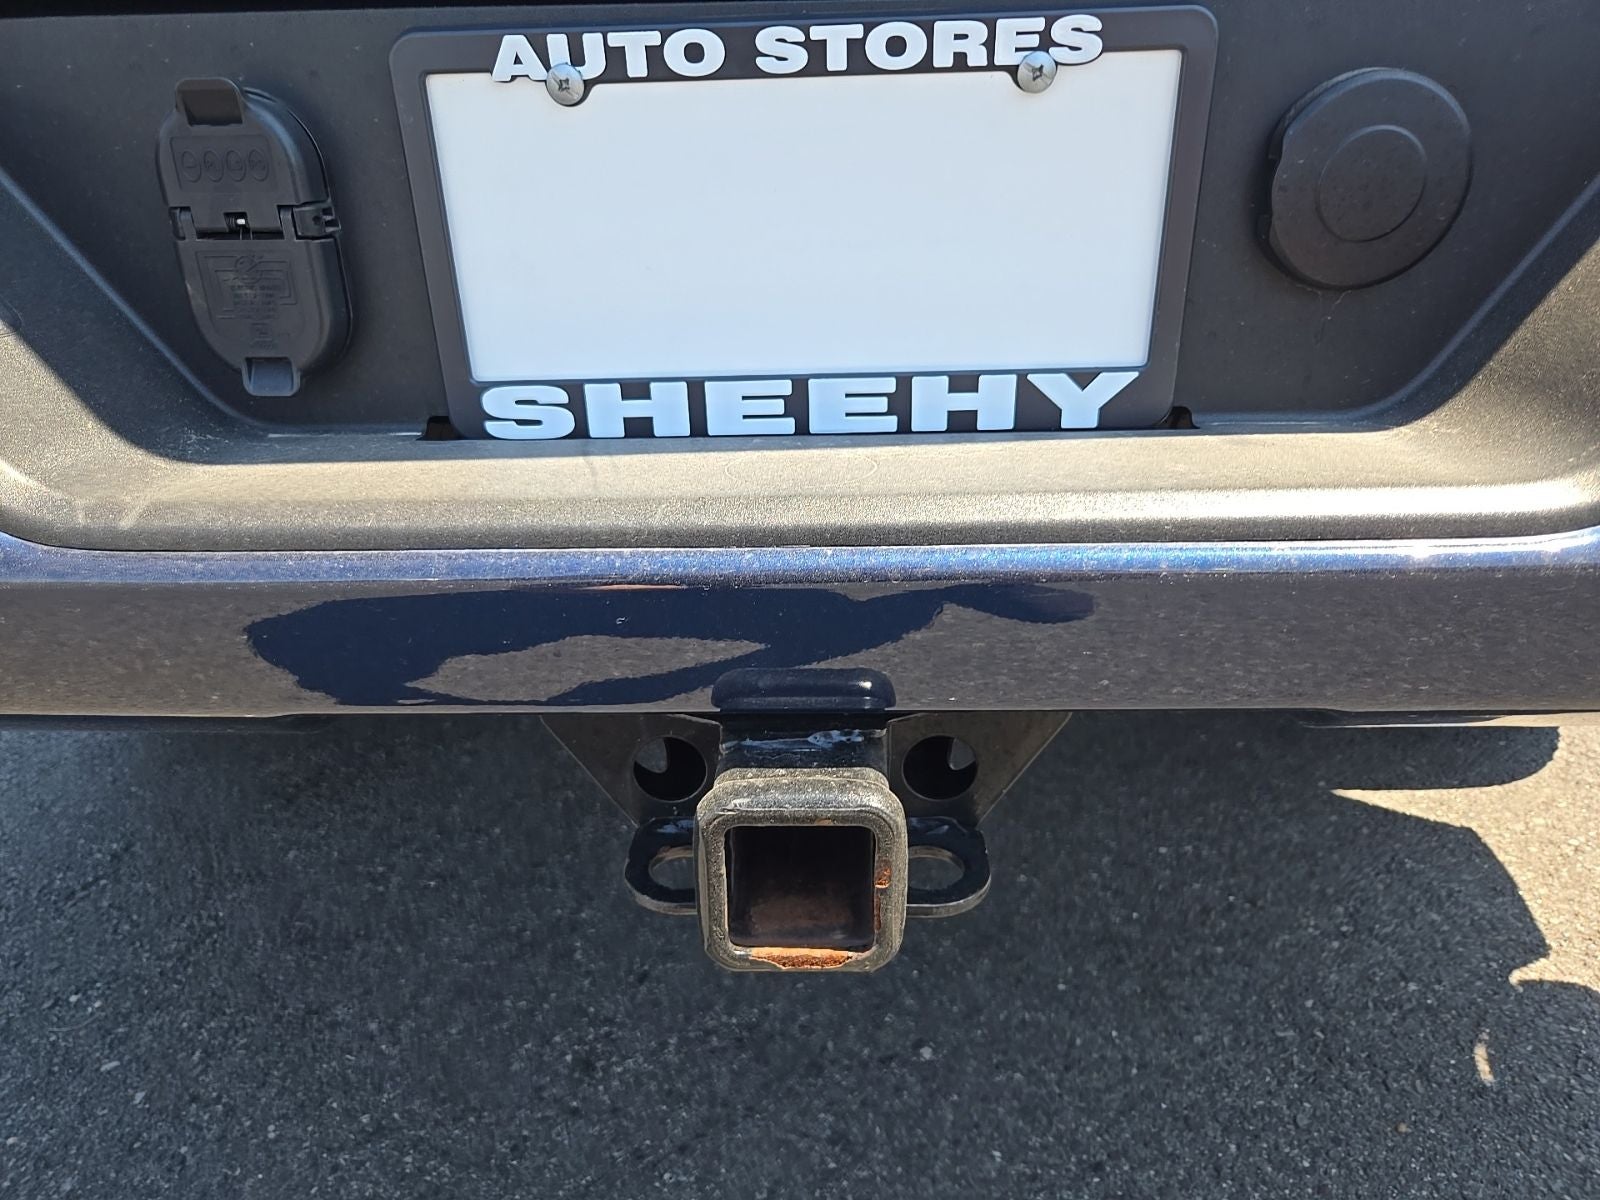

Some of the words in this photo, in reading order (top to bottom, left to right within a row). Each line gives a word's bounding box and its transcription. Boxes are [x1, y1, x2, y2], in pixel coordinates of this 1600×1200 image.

[491, 28, 725, 82] AUTO
[754, 14, 1103, 77] STORES
[481, 371, 1140, 440] SHEEHY
